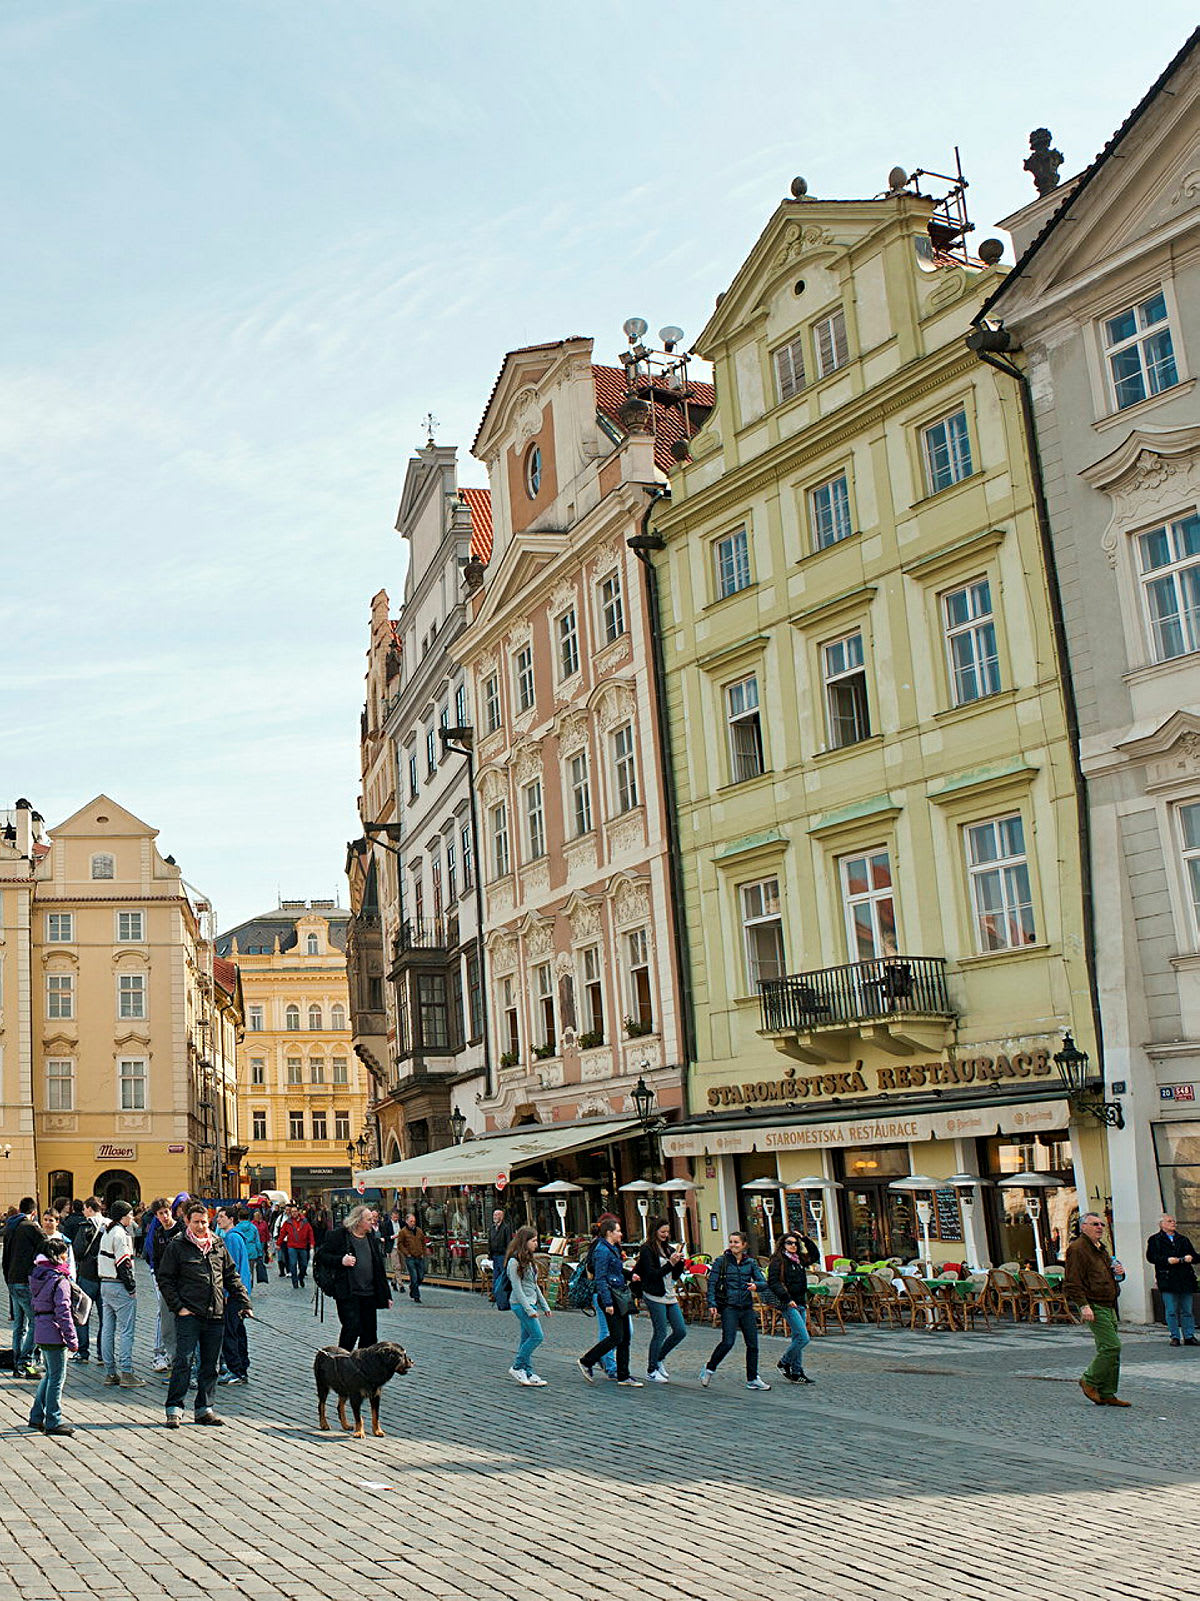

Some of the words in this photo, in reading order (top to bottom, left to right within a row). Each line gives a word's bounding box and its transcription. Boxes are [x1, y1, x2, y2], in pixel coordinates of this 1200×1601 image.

[707, 1060, 868, 1106] STAROMĚSTSKÁ
[877, 1050, 1051, 1089] RESTAURACE
[849, 1121, 918, 1141] RESTAURACE
[97, 1144, 134, 1158] Moser
